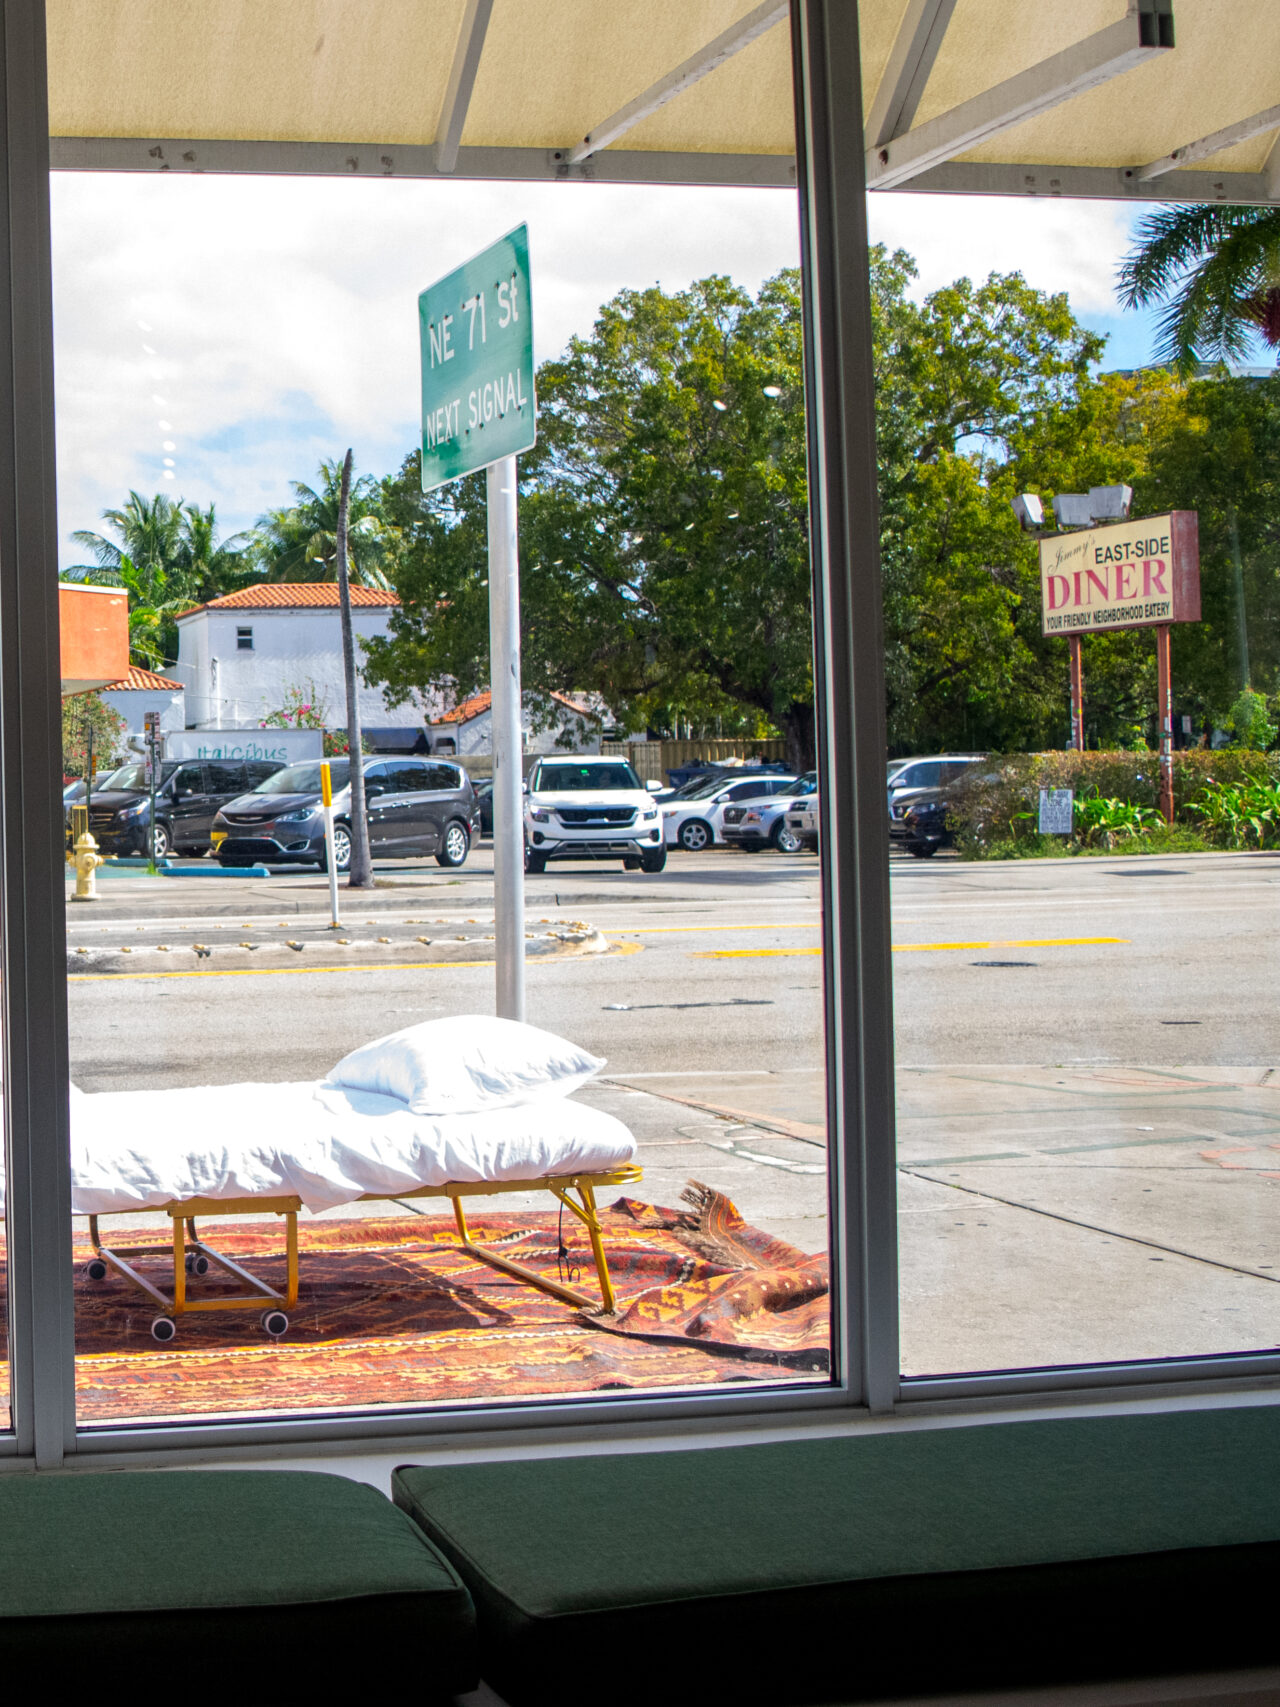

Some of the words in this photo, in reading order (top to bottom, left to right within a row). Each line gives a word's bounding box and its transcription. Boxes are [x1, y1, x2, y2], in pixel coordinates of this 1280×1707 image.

[430, 316, 454, 368] NE
[463, 292, 486, 350] 71
[498, 277, 518, 328] St
[426, 399, 460, 449] NEXT
[468, 368, 527, 428] SIGNAL
[1095, 536, 1169, 564] EAST-SIDE
[1046, 558, 1168, 610] DINER
[1046, 615, 1062, 629] YOUR
[1063, 611, 1091, 627] FRIENDLY
[1093, 605, 1143, 624] NEIGHBORHOOD
[1144, 601, 1170, 617] EATERY
